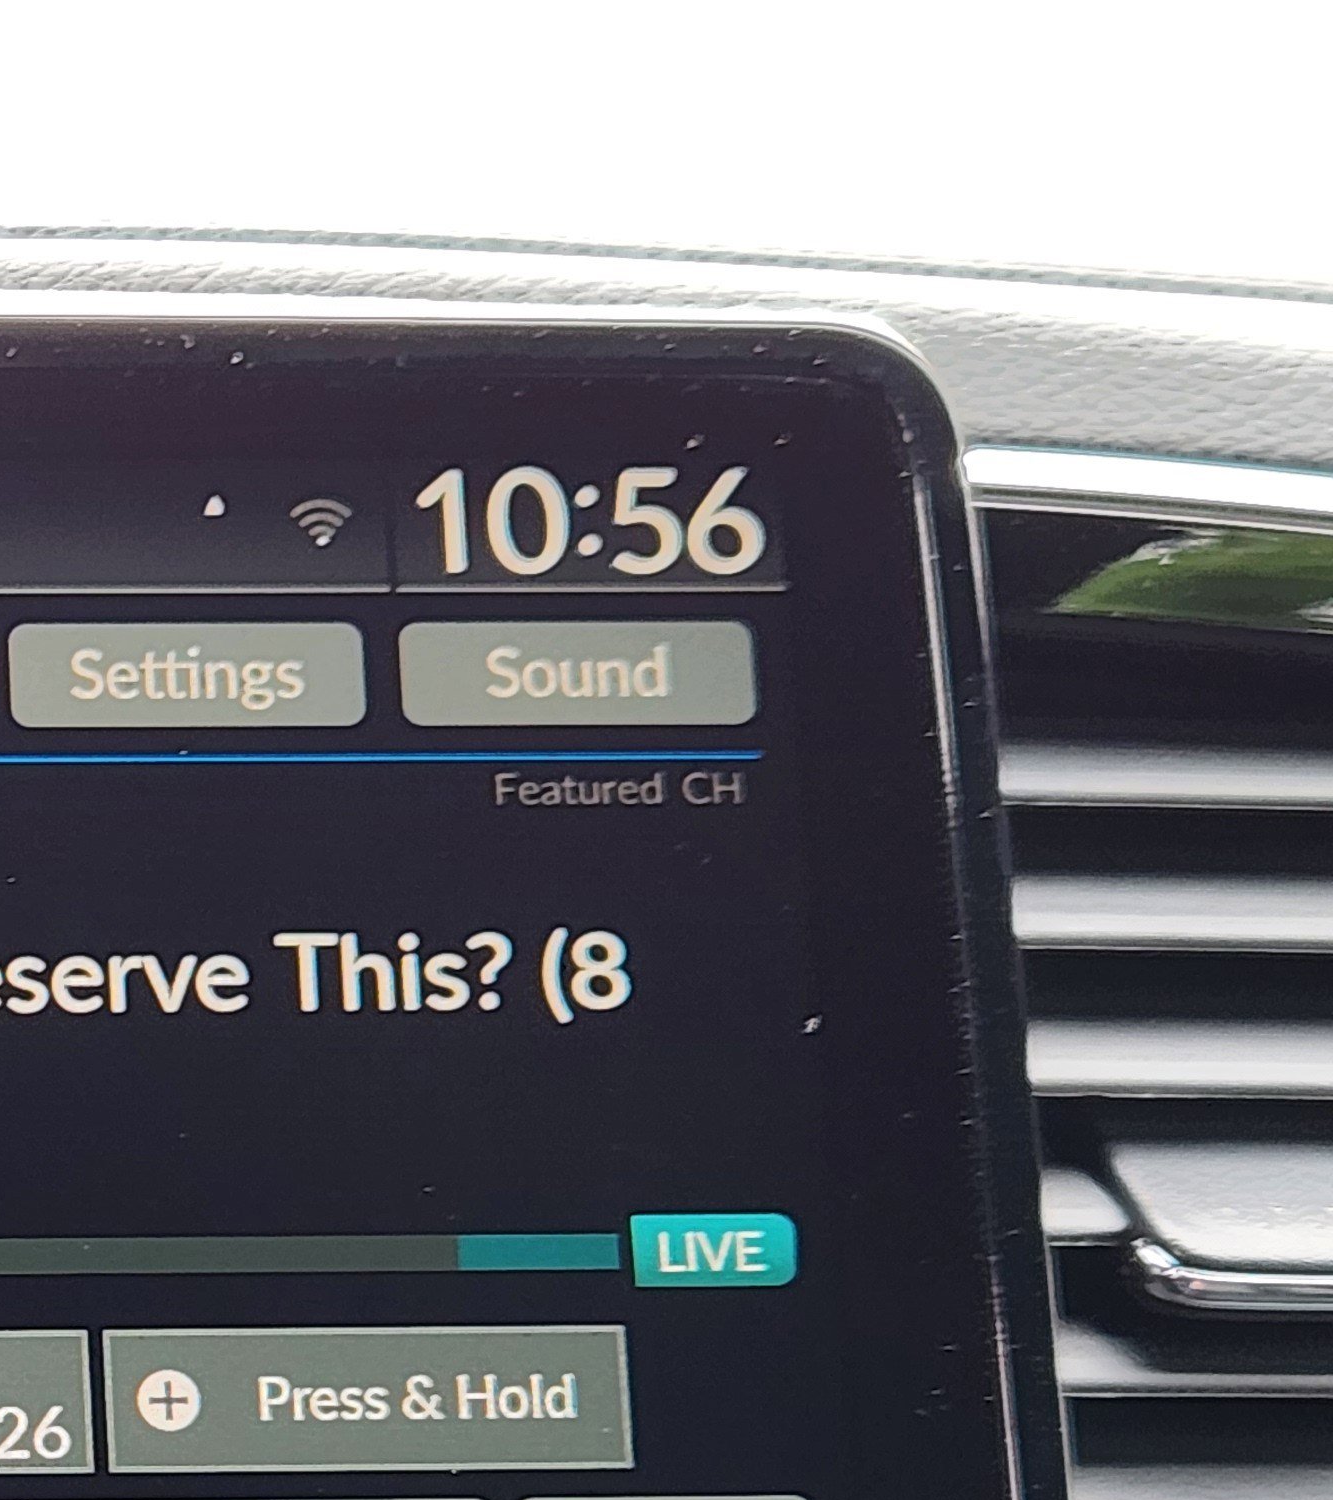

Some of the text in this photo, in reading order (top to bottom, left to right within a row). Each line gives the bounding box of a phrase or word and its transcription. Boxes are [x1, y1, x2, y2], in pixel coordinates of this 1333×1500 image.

[415, 466, 765, 575] 10:56
[69, 645, 305, 711] Settings
[485, 644, 670, 698] Sound
[494, 771, 743, 806] Featured CH
[273, 931, 512, 1012] This?
[541, 927, 632, 1024] (8
[657, 1230, 768, 1273] LIVE
[257, 1372, 578, 1422] Press & Hold
